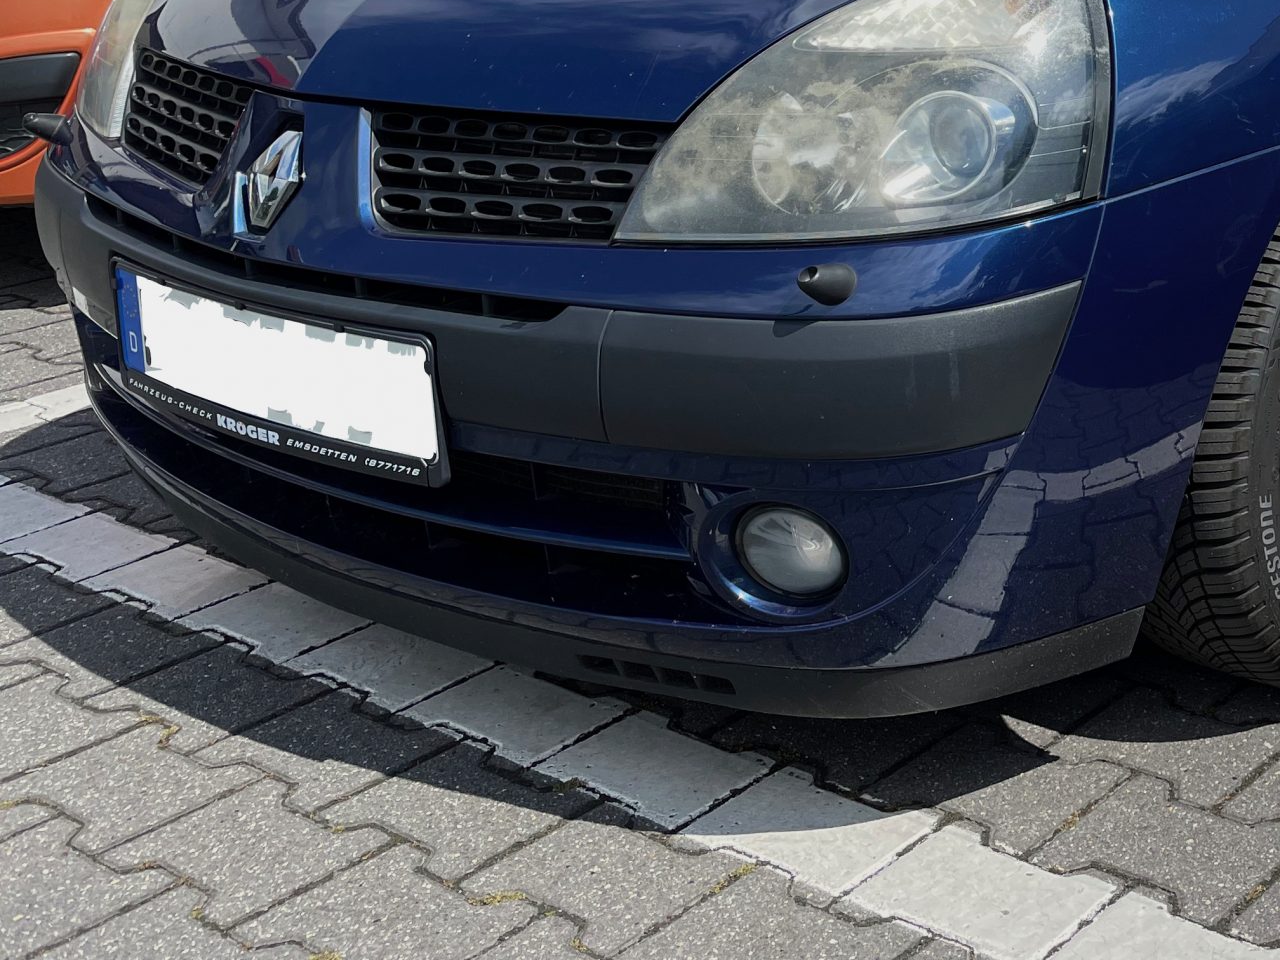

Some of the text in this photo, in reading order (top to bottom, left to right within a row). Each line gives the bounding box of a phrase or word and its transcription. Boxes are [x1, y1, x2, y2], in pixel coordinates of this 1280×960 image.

[129, 330, 138, 353] D
[129, 378, 213, 421] FAHRZEUG-CHECK
[216, 413, 281, 446] KRÖGER
[286, 438, 358, 463] EMSDETTEN
